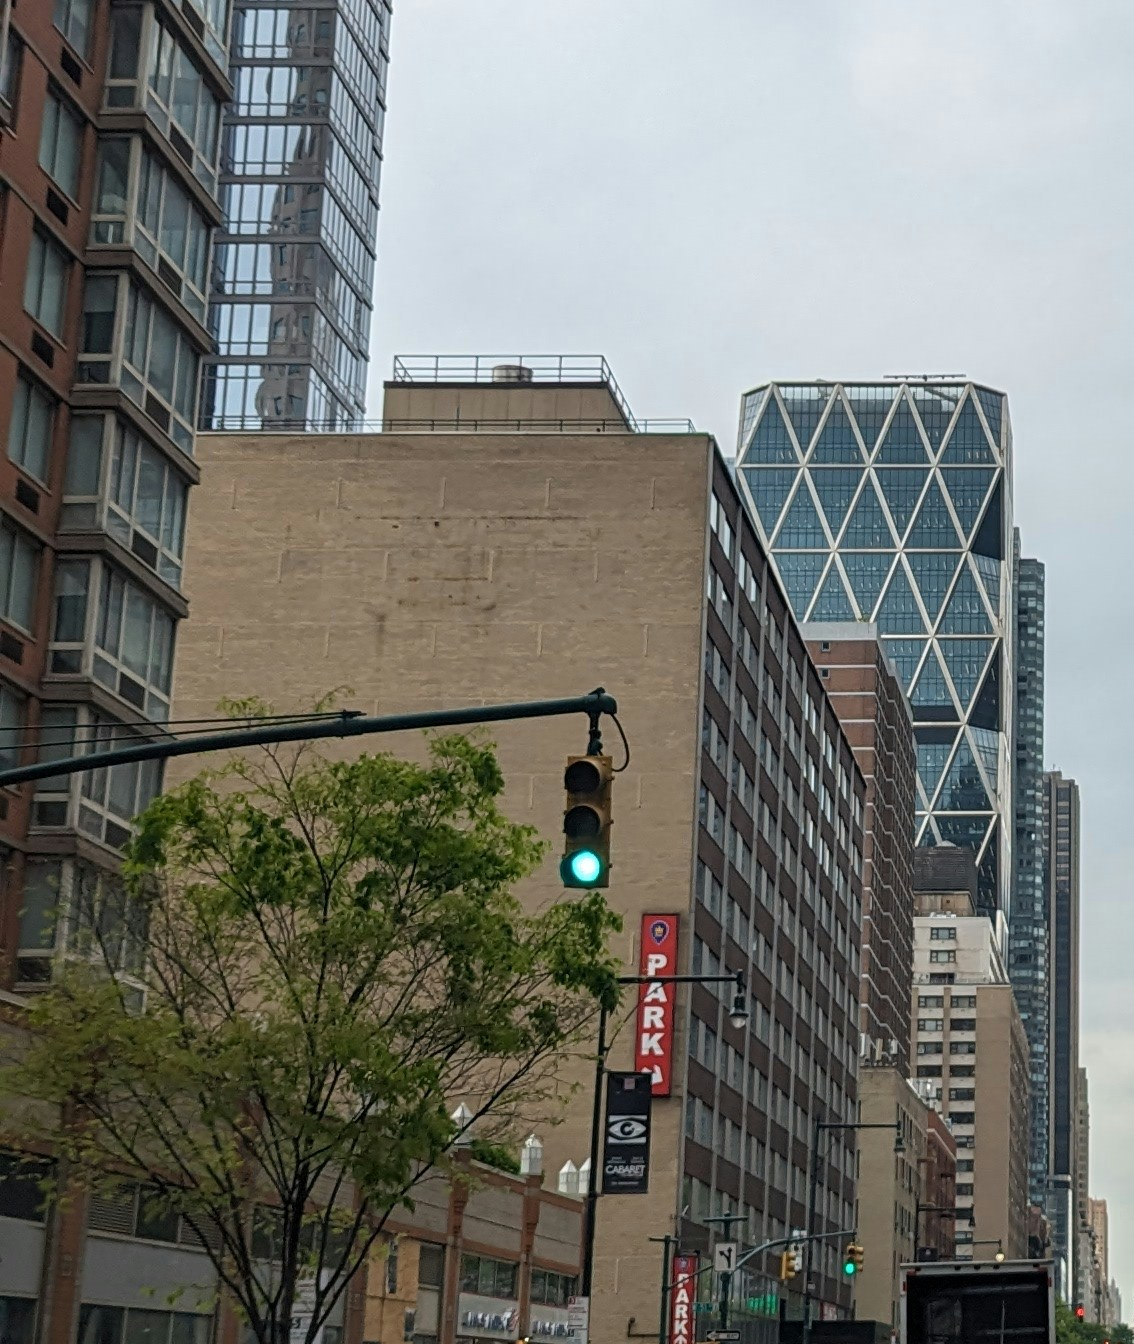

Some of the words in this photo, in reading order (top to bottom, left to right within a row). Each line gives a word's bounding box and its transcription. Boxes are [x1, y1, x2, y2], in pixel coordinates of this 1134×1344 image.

[641, 953, 667, 1056] PARK
[605, 1164, 646, 1176] CABARET
[674, 1273, 690, 1335] PARK
